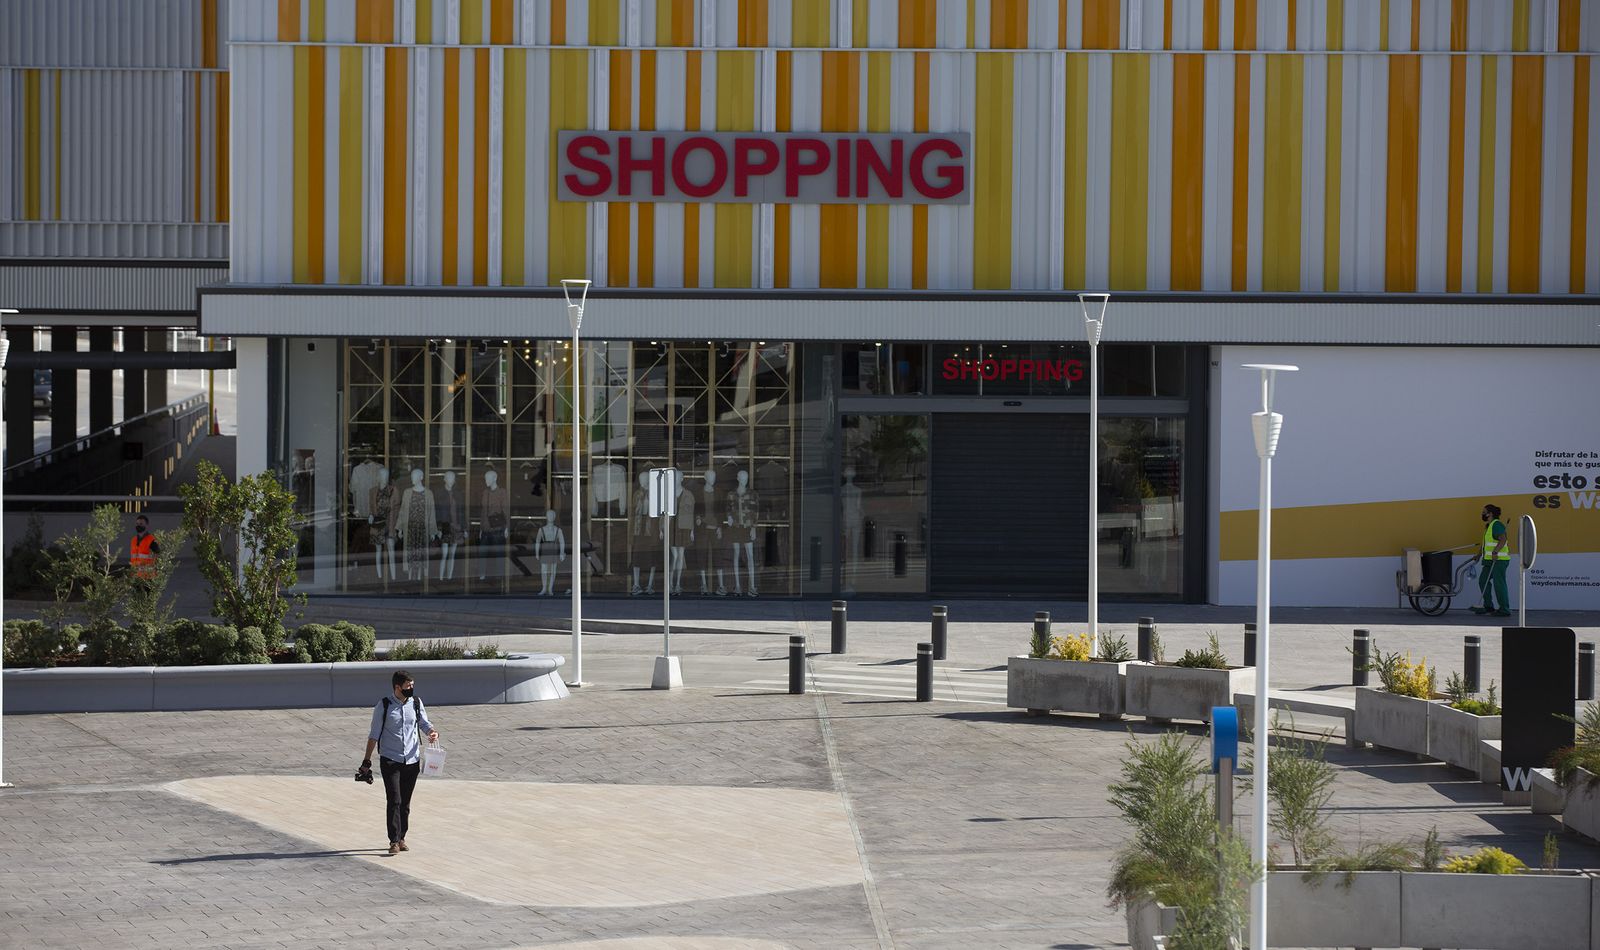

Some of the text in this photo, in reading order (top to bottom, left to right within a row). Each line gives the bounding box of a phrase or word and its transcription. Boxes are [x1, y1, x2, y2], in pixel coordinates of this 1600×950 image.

[564, 135, 964, 200] SHOPPING
[942, 358, 1083, 381] SHOPPING
[1535, 450, 1575, 458] Disfrutar
[1533, 473, 1587, 489] esto
[1533, 495, 1560, 508] es
